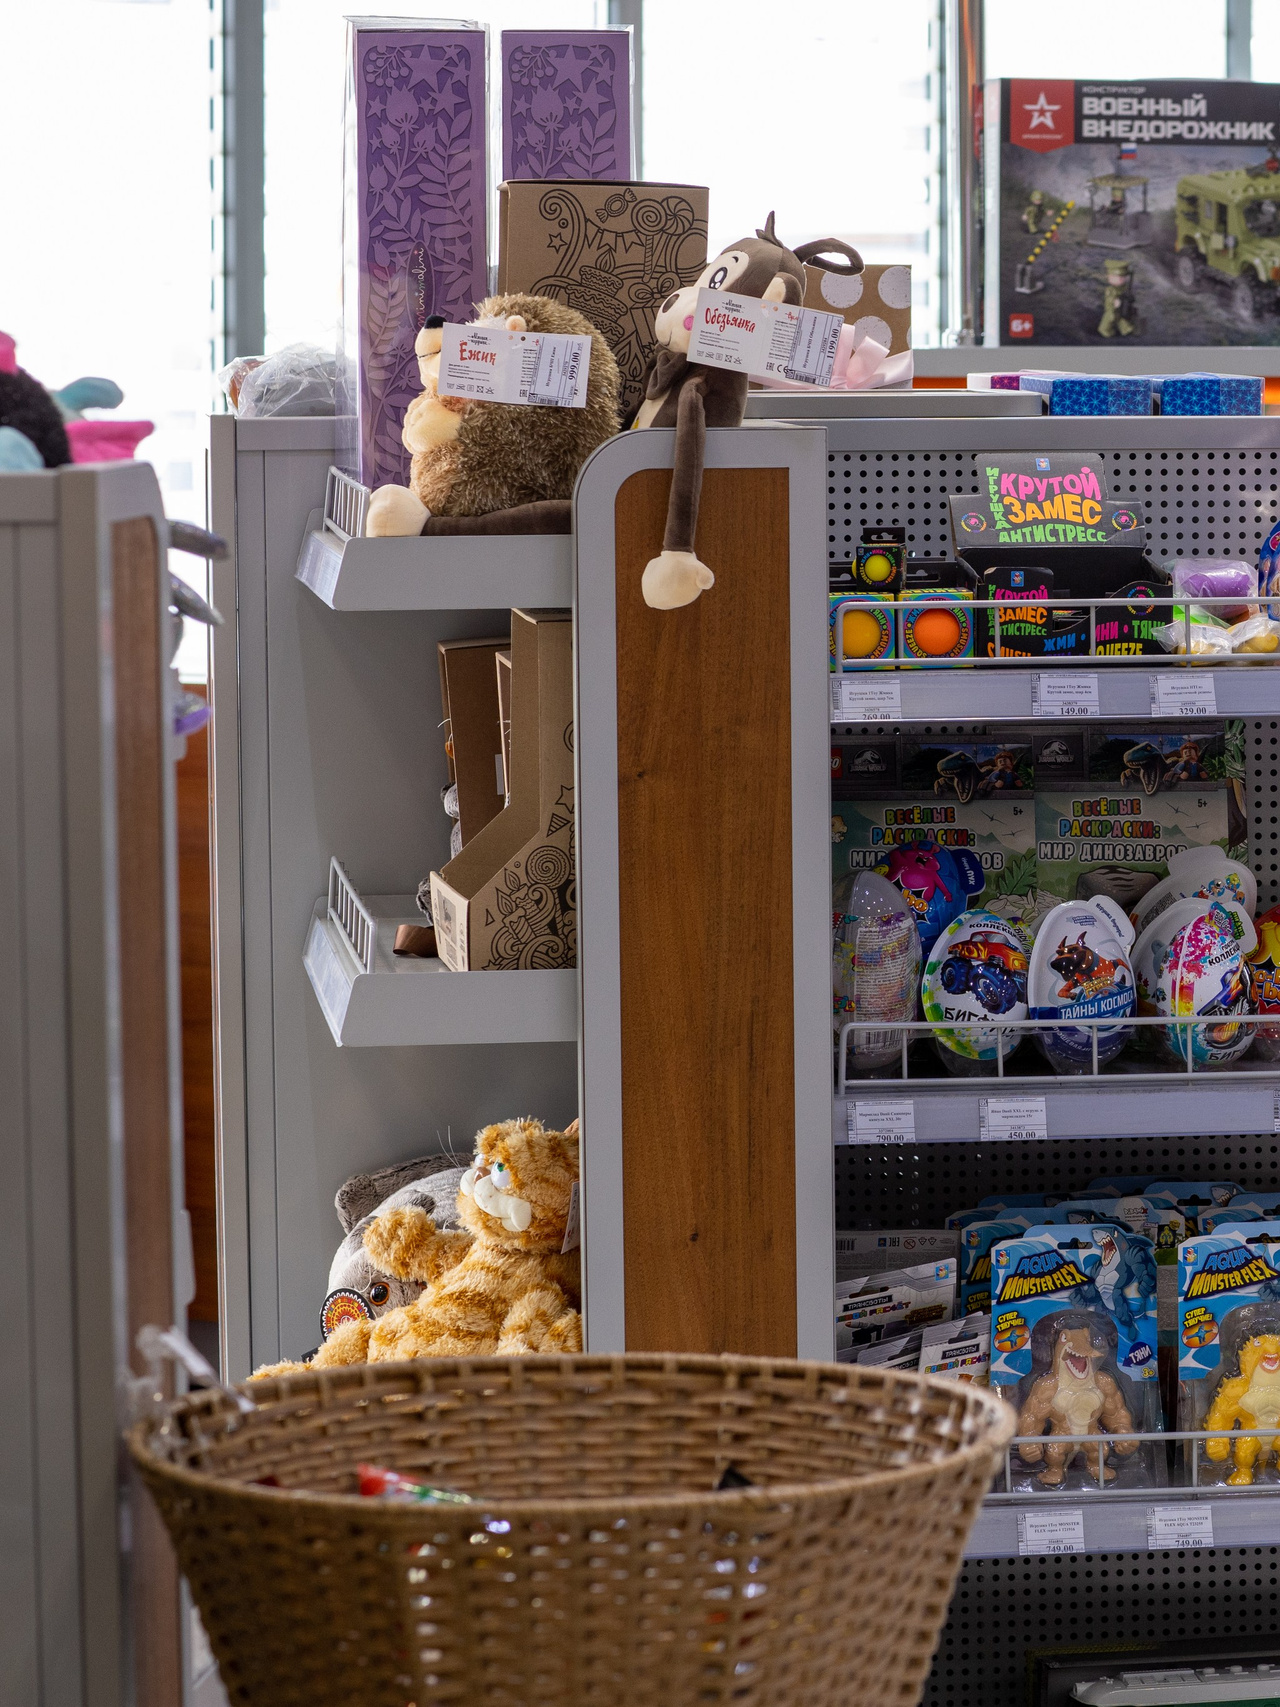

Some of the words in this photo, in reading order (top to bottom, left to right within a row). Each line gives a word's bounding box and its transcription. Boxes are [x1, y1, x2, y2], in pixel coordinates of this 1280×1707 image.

[1082, 94, 1207, 117] ВОЕННЫЙ
[1082, 119, 1276, 142] ВНЕДОРОЖНИК
[704, 307, 757, 333] Обезьянка
[1010, 318, 1033, 334] 6+
[459, 339, 497, 366] Ёжик
[827, 328, 839, 359] 1199.00
[568, 352, 581, 380] 999.00
[1000, 466, 1102, 502] КРУТОЙ
[985, 467, 1013, 530] ИГРУШКА
[1003, 493, 1103, 526] ЗАМЕС
[998, 523, 1108, 543] АНТИСТРЕСС
[988, 623, 1047, 636] АТИСТРЕСС
[1043, 633, 1076, 652] ЖМИ
[1060, 707, 1088, 715] 149.00
[1179, 707, 1207, 715] 329.00
[1013, 807, 1023, 816] 5+
[1072, 797, 1142, 816] ВЕСЁЛЫЕ
[1197, 799, 1207, 808] 5+
[885, 806, 955, 825] ВЕСЁЛЫЕ
[1060, 820, 1161, 838] РАСКРАСКИ:
[1039, 842, 1075, 860] МИР
[1060, 1004, 1099, 1019] ТАЙНЫ
[1101, 990, 1133, 1013] КОСМОСА
[876, 1134, 905, 1142] 790.00
[1008, 1131, 1036, 1140] 450.00
[1017, 1251, 1063, 1274] AQUA
[1205, 1248, 1252, 1271] AQUA
[1001, 1271, 1054, 1301] MONSTER
[1055, 1263, 1088, 1289] FLEX
[1188, 1268, 1243, 1298] MONSTER
[1244, 1258, 1278, 1284] FLEX
[848, 1297, 889, 1310] ТРАНСБОТЫ
[1185, 1307, 1206, 1318] СУПЕР
[998, 1311, 1018, 1323] СУПЕР
[1046, 1545, 1074, 1553] 749.00
[1175, 1539, 1203, 1548] 749.00
